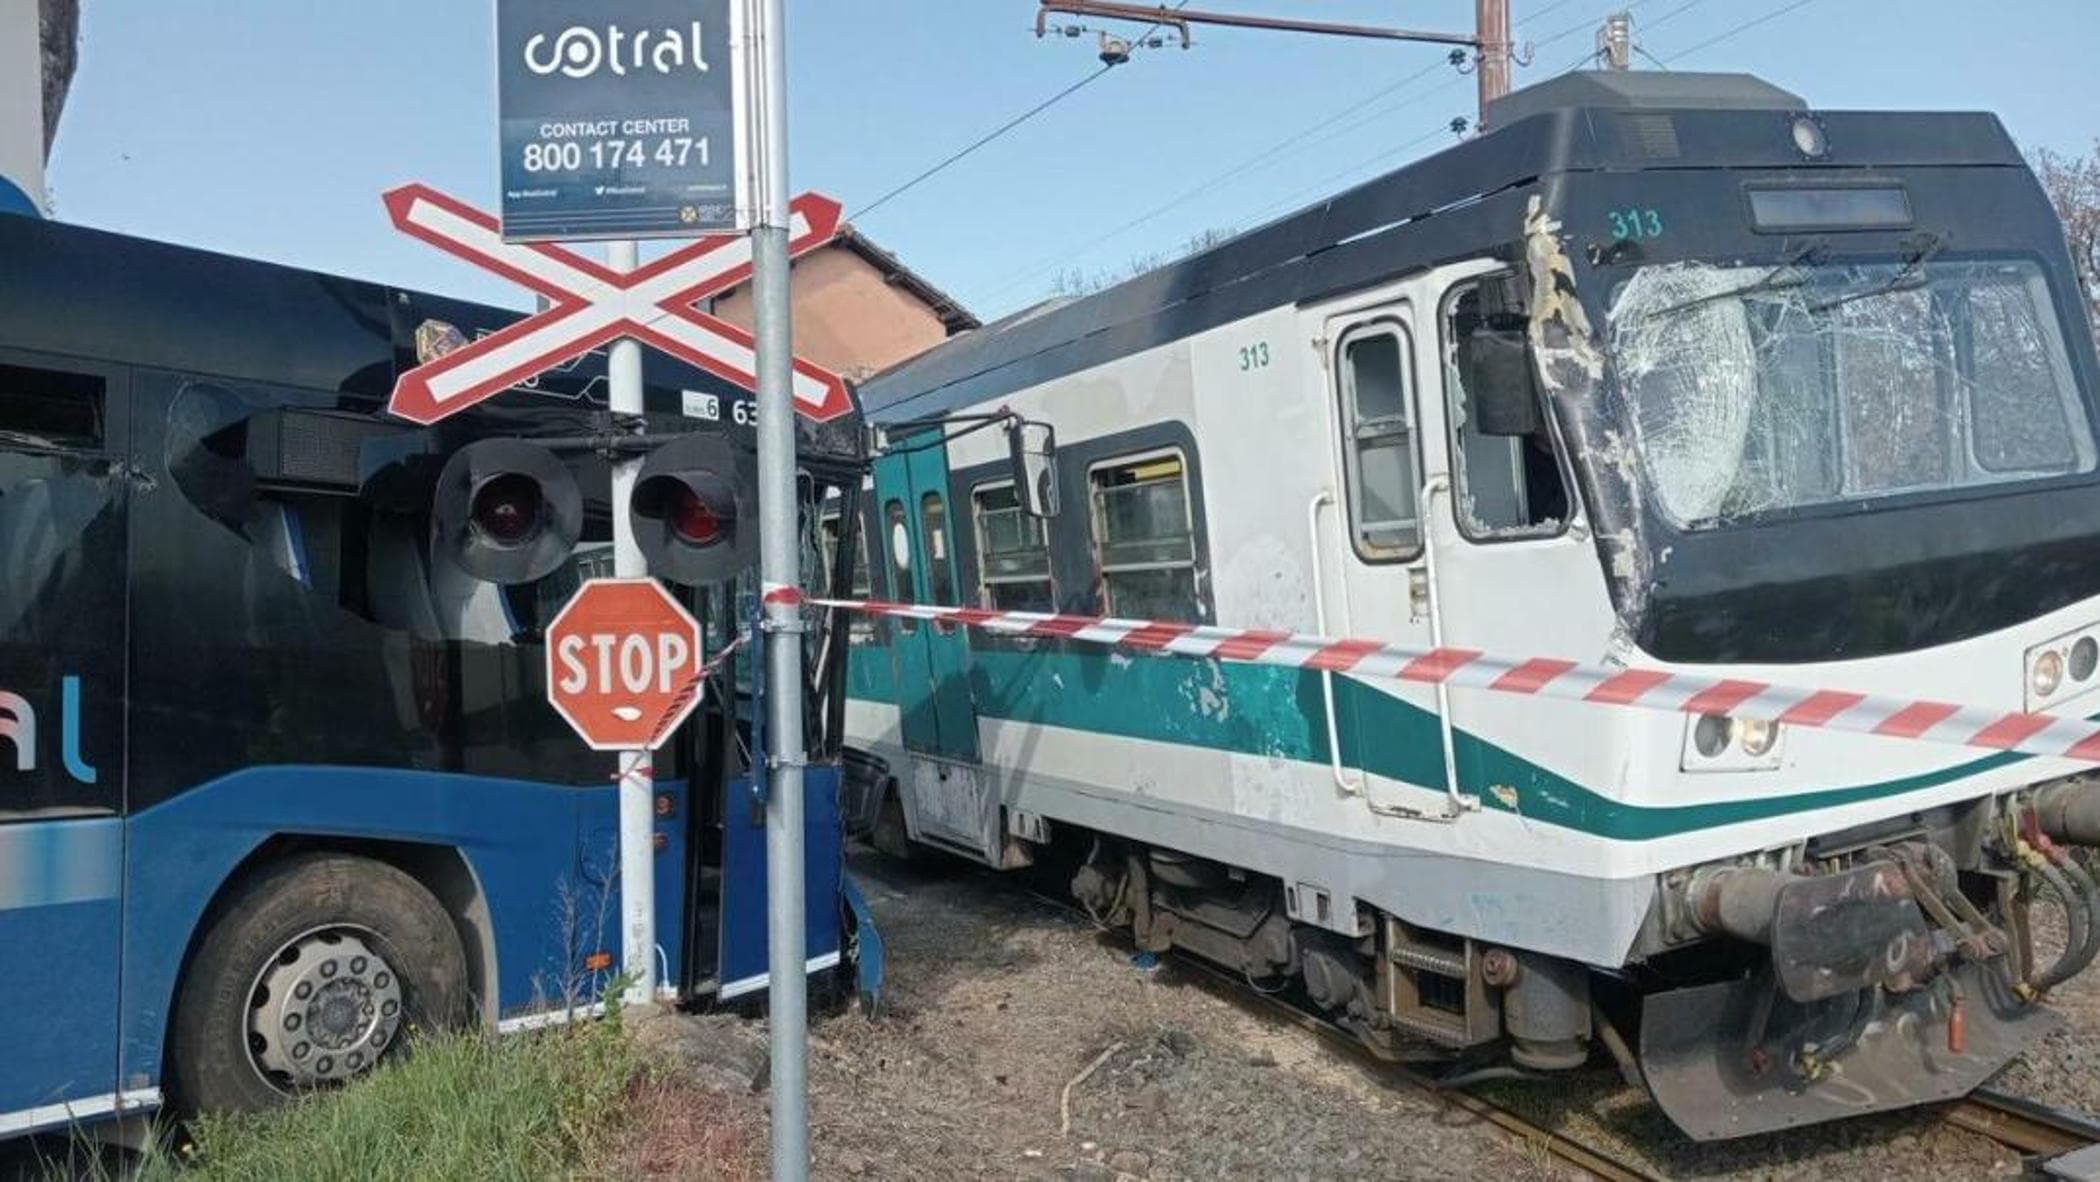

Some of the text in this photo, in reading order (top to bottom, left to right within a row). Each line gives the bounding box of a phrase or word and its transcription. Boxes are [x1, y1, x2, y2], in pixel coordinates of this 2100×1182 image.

[524, 21, 709, 78] cotral
[540, 118, 690, 138] CONTACT CENTER
[523, 137, 709, 172] 800 174 471
[1608, 208, 1662, 239] 313
[1240, 341, 1269, 371] 313
[707, 399, 718, 418] 6
[559, 633, 689, 695] STOP
